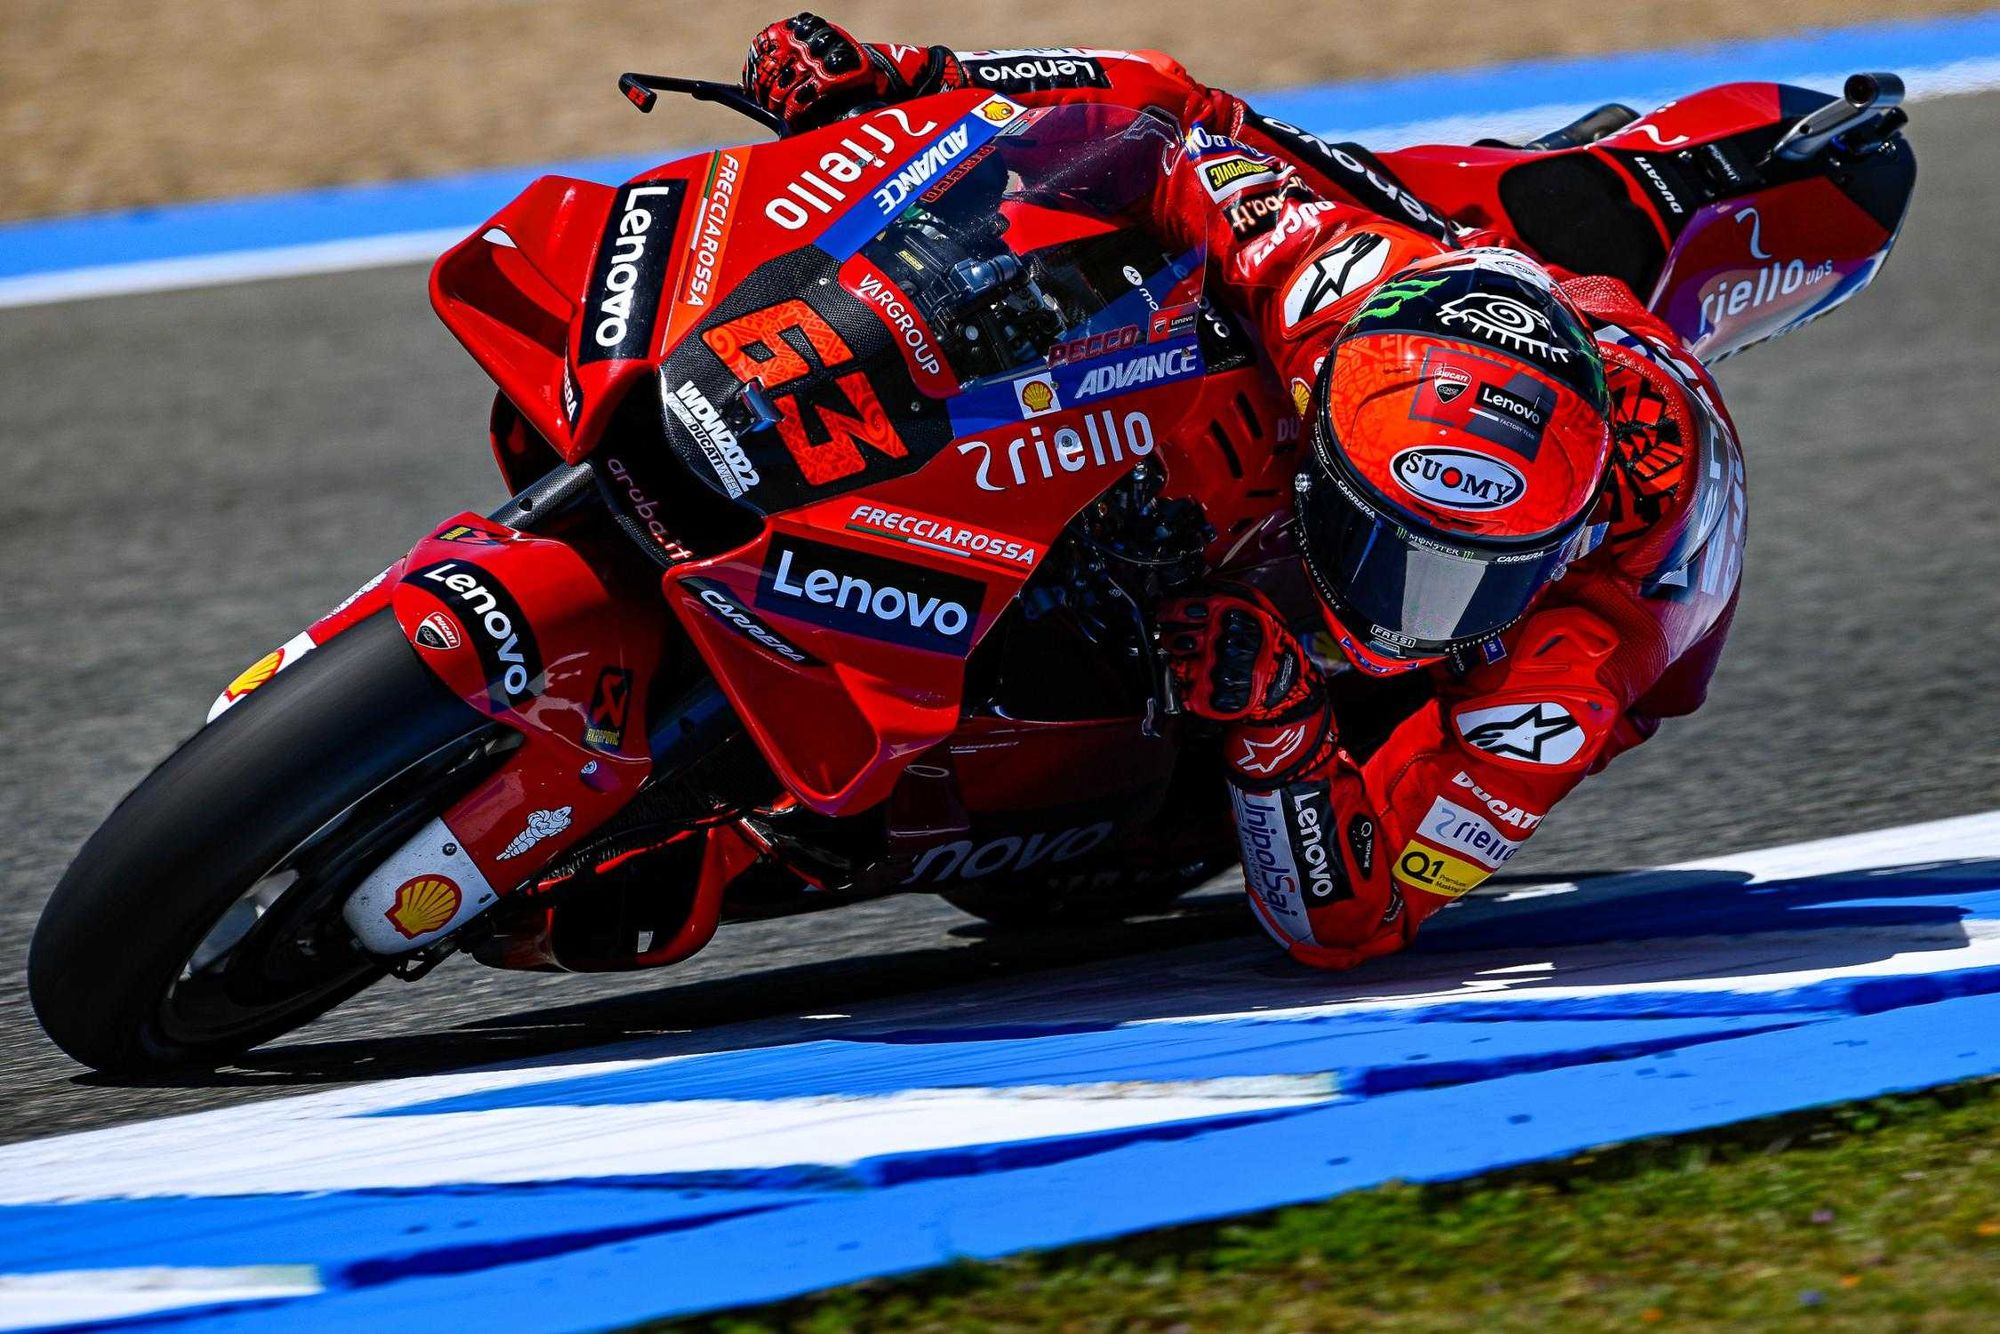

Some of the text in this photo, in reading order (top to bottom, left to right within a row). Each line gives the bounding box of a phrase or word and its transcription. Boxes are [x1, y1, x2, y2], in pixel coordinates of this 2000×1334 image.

[979, 58, 1096, 82] Lenovo
[764, 123, 896, 230] riello
[873, 122, 969, 215] ADVANCE
[1634, 156, 1683, 213] DUCATI
[686, 152, 740, 307] FRECCIAROSSA
[595, 185, 669, 347] Lenovo
[1700, 258, 1833, 329] riello ups
[1049, 325, 1140, 367] PECCO
[1074, 344, 1197, 399] ADVANCE
[702, 299, 907, 486] 63
[1438, 369, 1468, 382] DUCATI
[1482, 387, 1540, 425] Lenovo
[1499, 419, 1522, 432] FACTORY
[676, 380, 760, 492] WDW2022
[1008, 409, 1155, 485] riello
[1337, 480, 1375, 519] CARRERA
[1405, 452, 1513, 505] SUOMY
[608, 459, 693, 560] aruba.it
[850, 505, 1036, 565] FRECCIAROSSA
[1409, 533, 1459, 556] MONSTER
[1497, 551, 1544, 563] CARRERA
[773, 550, 968, 636] Lenovo
[423, 563, 527, 695] Lenovo
[433, 615, 457, 644] DUCATI
[700, 589, 805, 663] CARRERA
[1374, 626, 1413, 646] FASSI
[1451, 771, 1545, 829] DUCATI
[900, 821, 1113, 884] novo
[1294, 791, 1333, 897] Lenovo
[1401, 852, 1445, 885] Q1
[1453, 821, 1519, 862] riello
[1434, 881, 1460, 894] Masking
